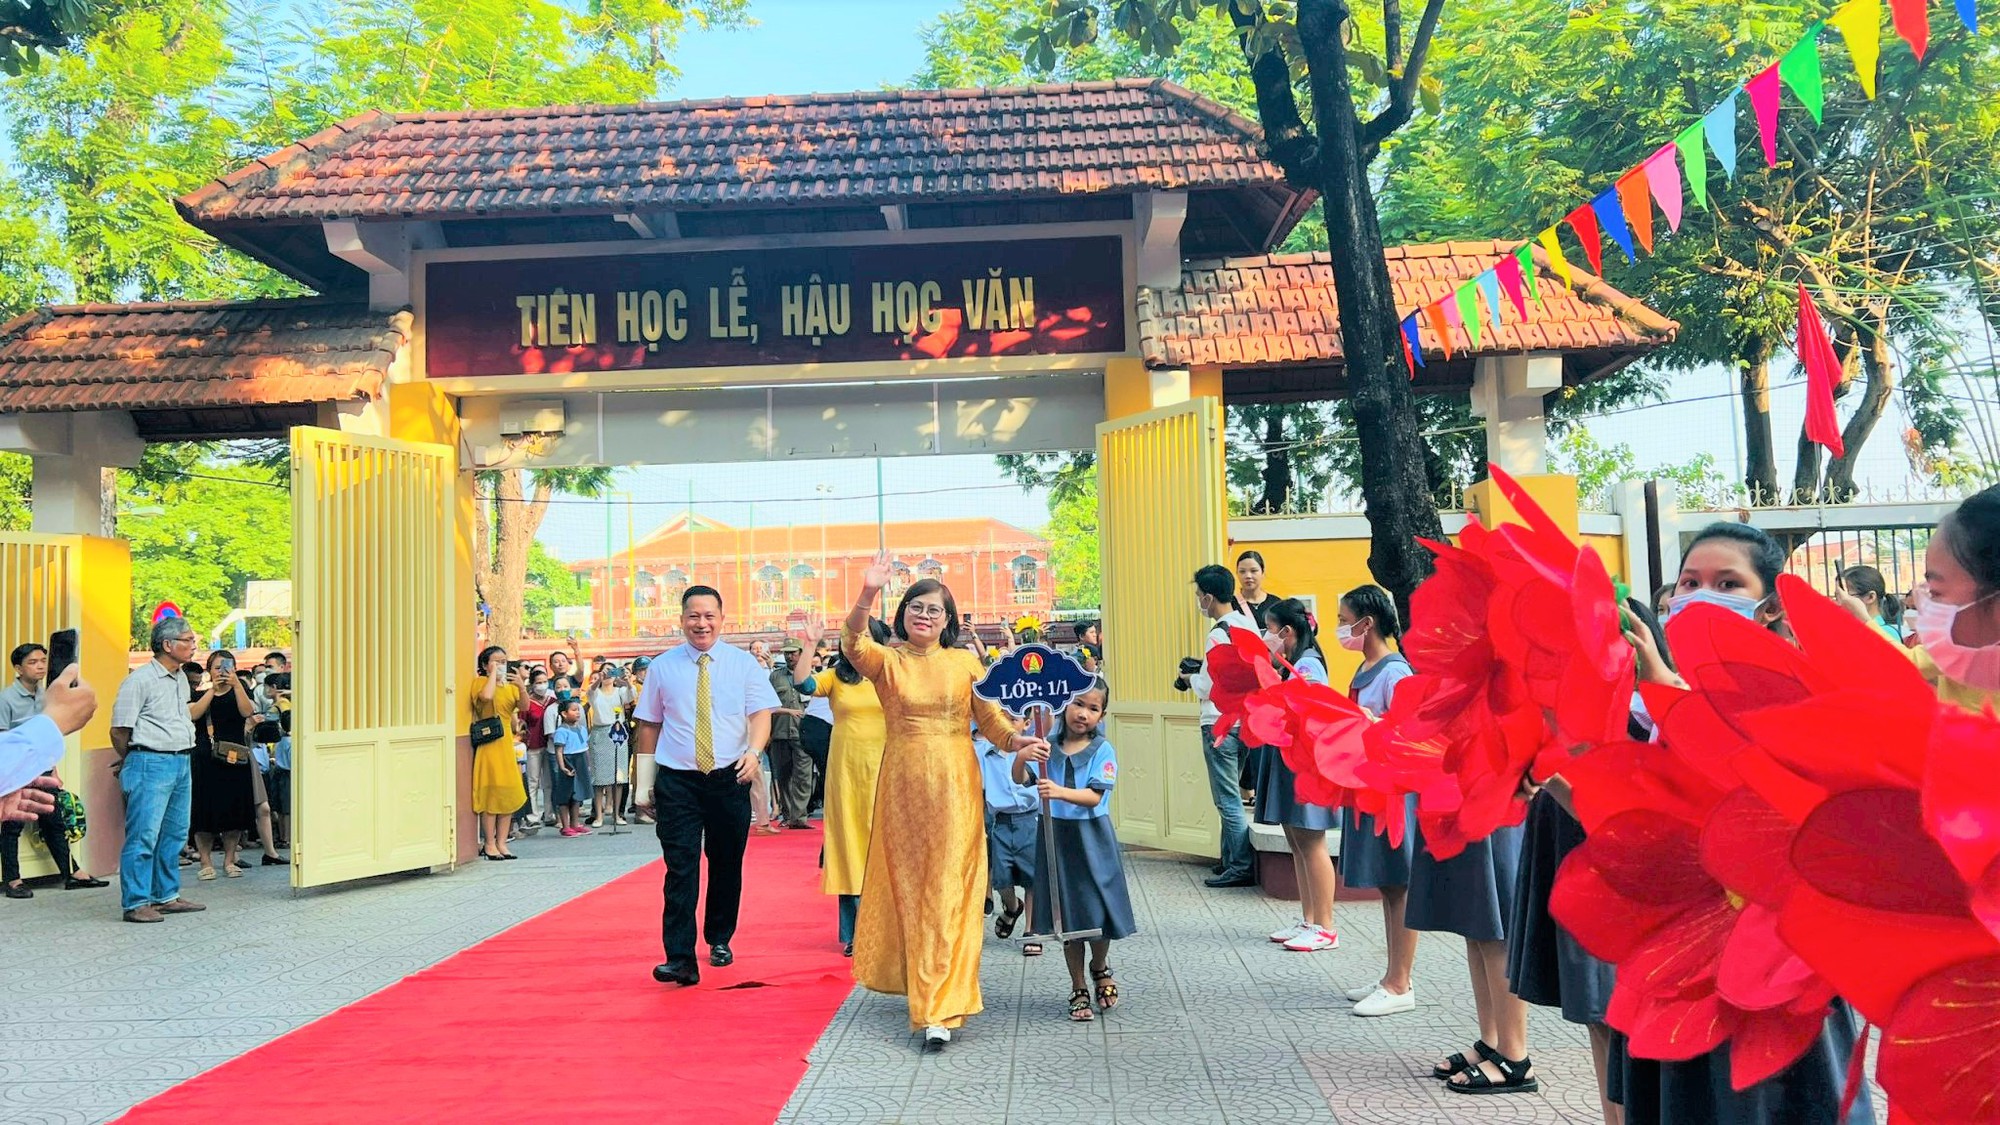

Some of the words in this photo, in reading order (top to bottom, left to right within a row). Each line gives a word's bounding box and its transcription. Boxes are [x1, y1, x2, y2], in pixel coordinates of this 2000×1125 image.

[516, 287, 596, 347] TIÊN
[617, 289, 688, 352] HỌC
[709, 266, 758, 344] LỄ,
[781, 273, 850, 346] HẬU
[872, 281, 942, 345] HỌC
[962, 267, 1035, 330] VĂN
[1000, 678, 1043, 700] LỚP:
[1048, 679, 1070, 696] 1/1
